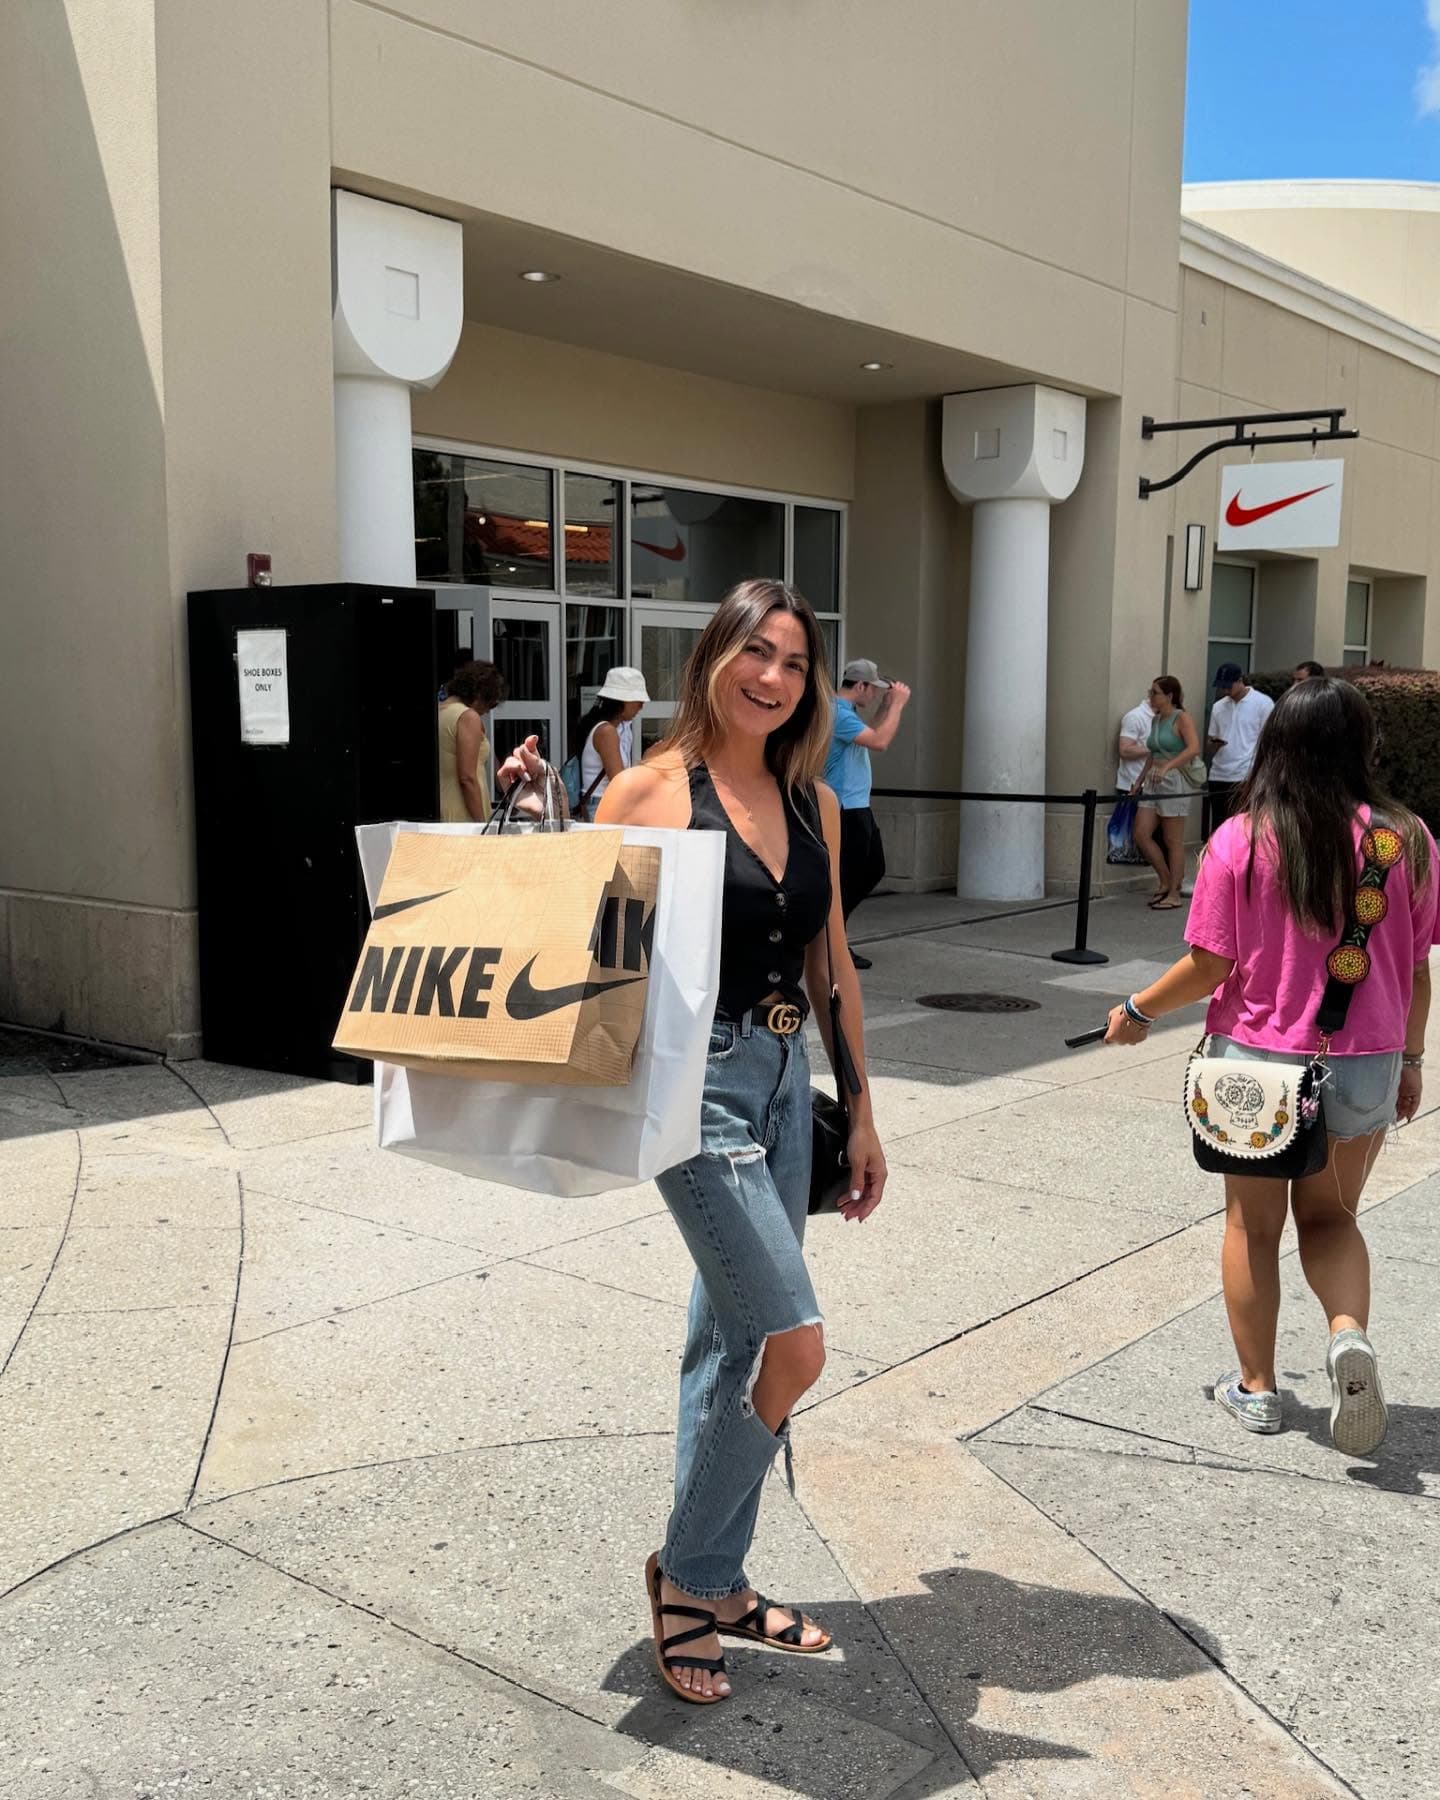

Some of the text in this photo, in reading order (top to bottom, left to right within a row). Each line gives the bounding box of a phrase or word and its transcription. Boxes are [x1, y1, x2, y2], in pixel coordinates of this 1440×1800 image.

[244, 668, 282, 677] SHOE BOXES
[255, 683, 272, 692] ONLY
[593, 897, 656, 973] IK
[349, 946, 502, 1019] NIKE
